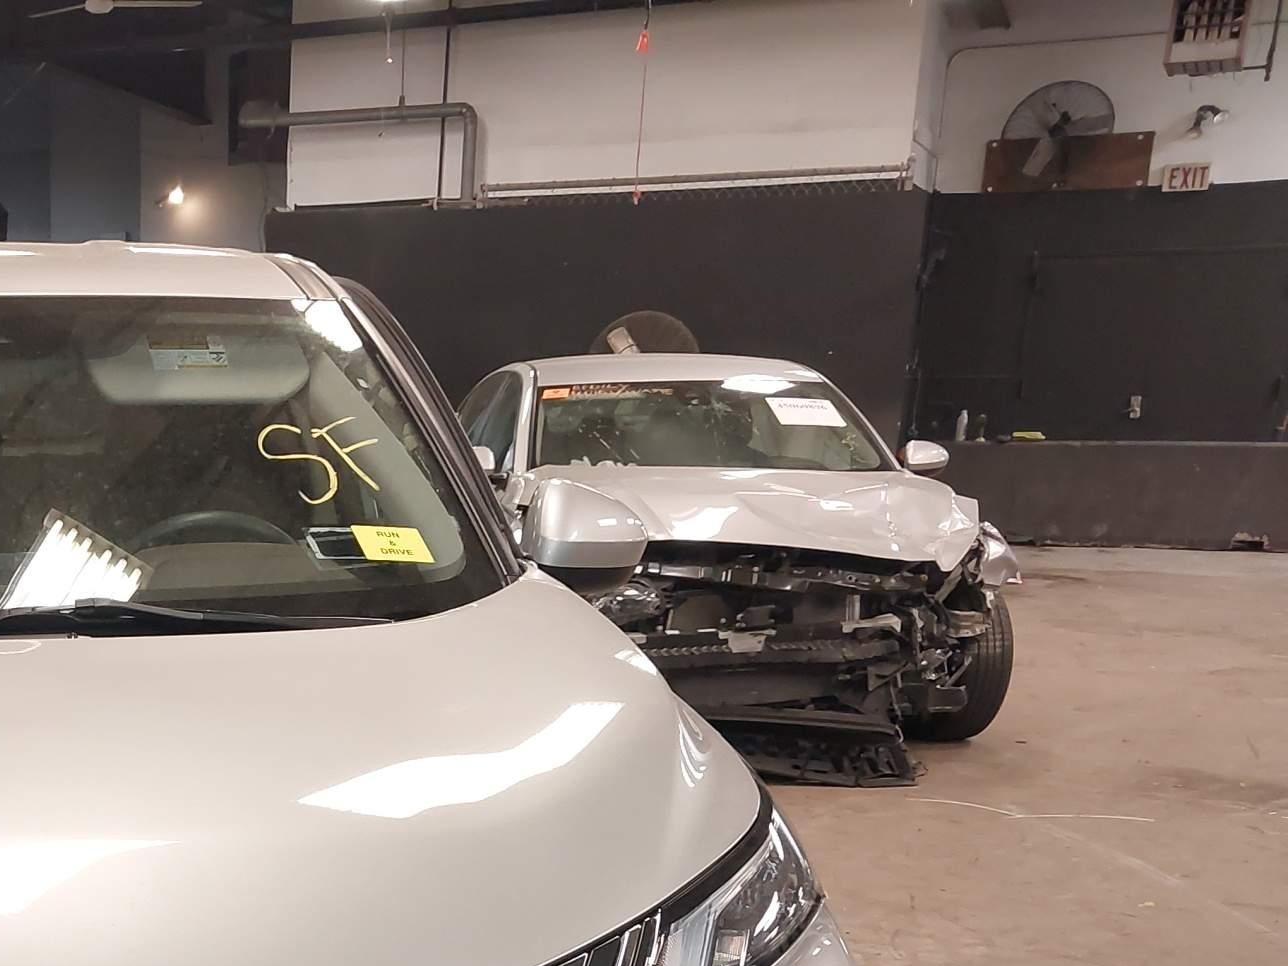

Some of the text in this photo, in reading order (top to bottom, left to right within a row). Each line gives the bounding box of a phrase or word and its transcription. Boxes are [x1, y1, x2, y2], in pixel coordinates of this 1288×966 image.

[1168, 166, 1209, 190] EXIT
[375, 530, 401, 539] RUN
[380, 547, 416, 556] DRIVE
